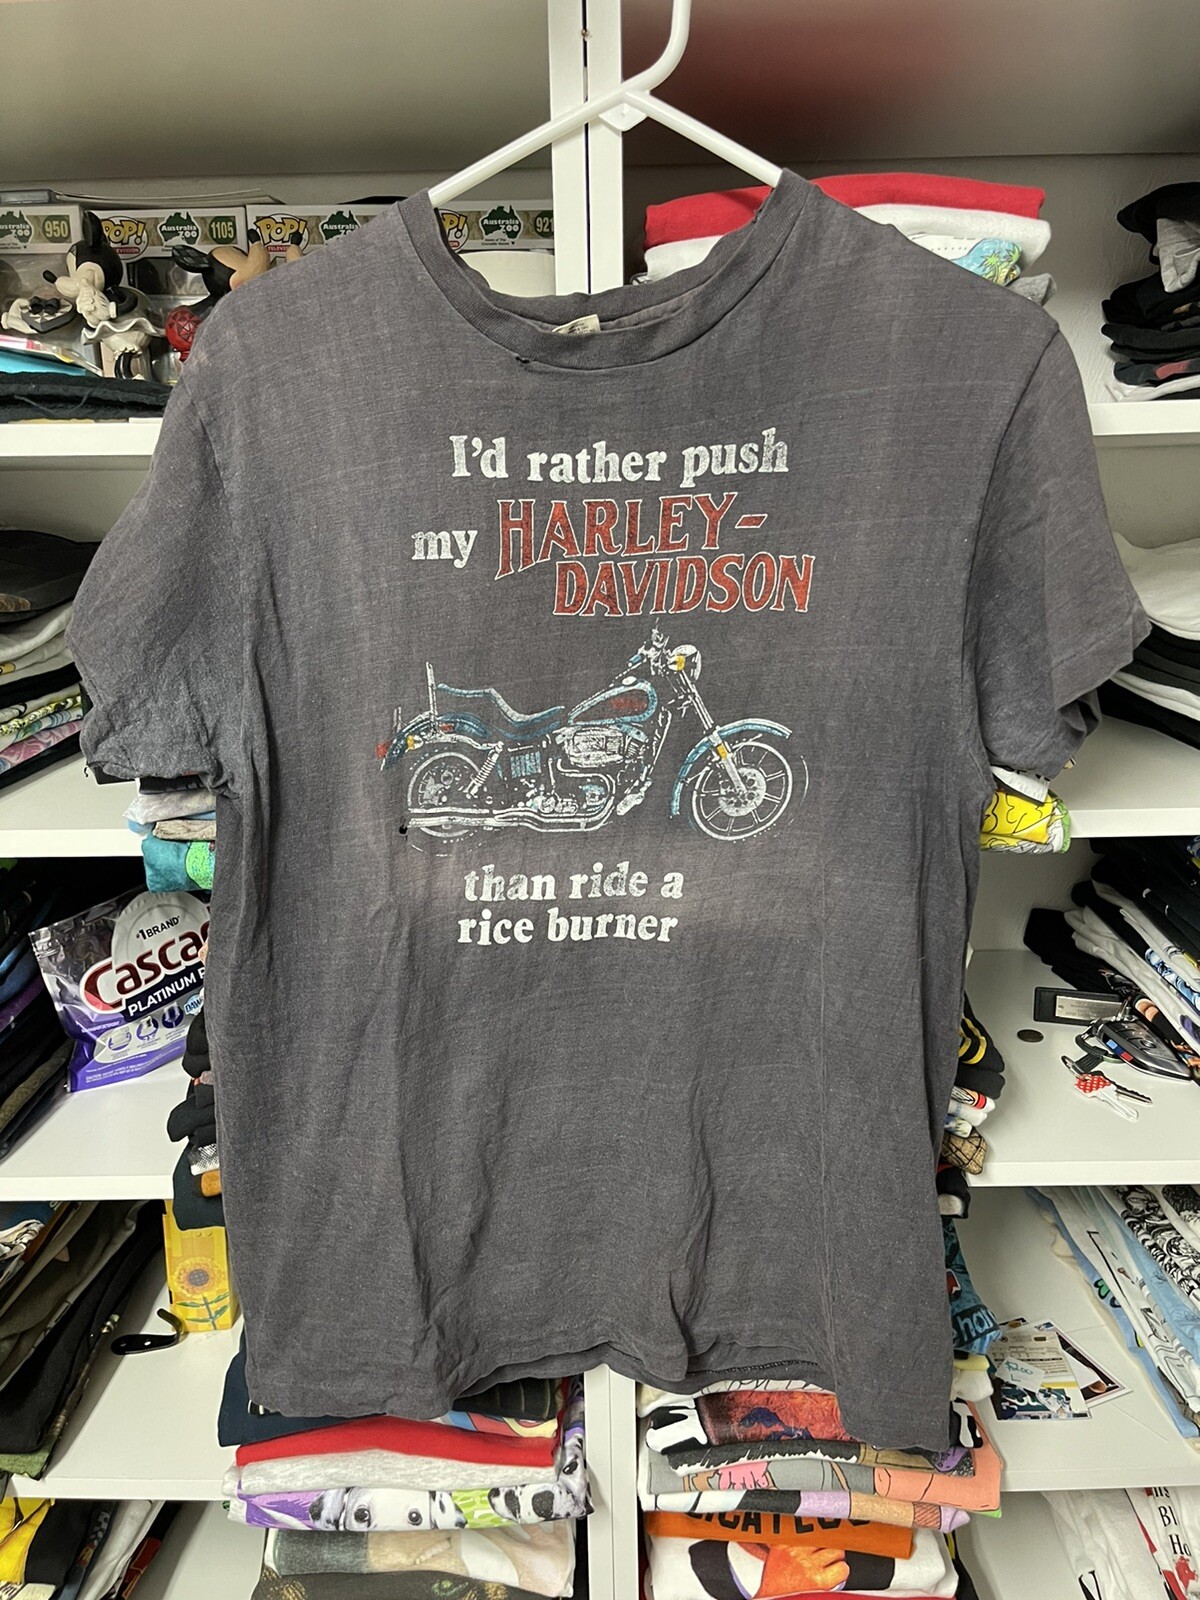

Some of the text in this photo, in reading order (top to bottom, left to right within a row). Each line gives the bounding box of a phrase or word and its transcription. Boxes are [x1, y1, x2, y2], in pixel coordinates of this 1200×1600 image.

[0, 222, 31, 230] ustralia
[44, 220, 69, 239] 950
[161, 224, 197, 232] Australia
[211, 221, 235, 239] 1105
[483, 218, 519, 226] Australia
[449, 427, 789, 488] I'd rather push
[411, 492, 768, 580] my HARLEY-
[553, 551, 815, 617] DAVIDSON
[464, 861, 684, 902] than ride a
[457, 907, 679, 946] rice burner
[128, 972, 197, 1017] PLATINUM
